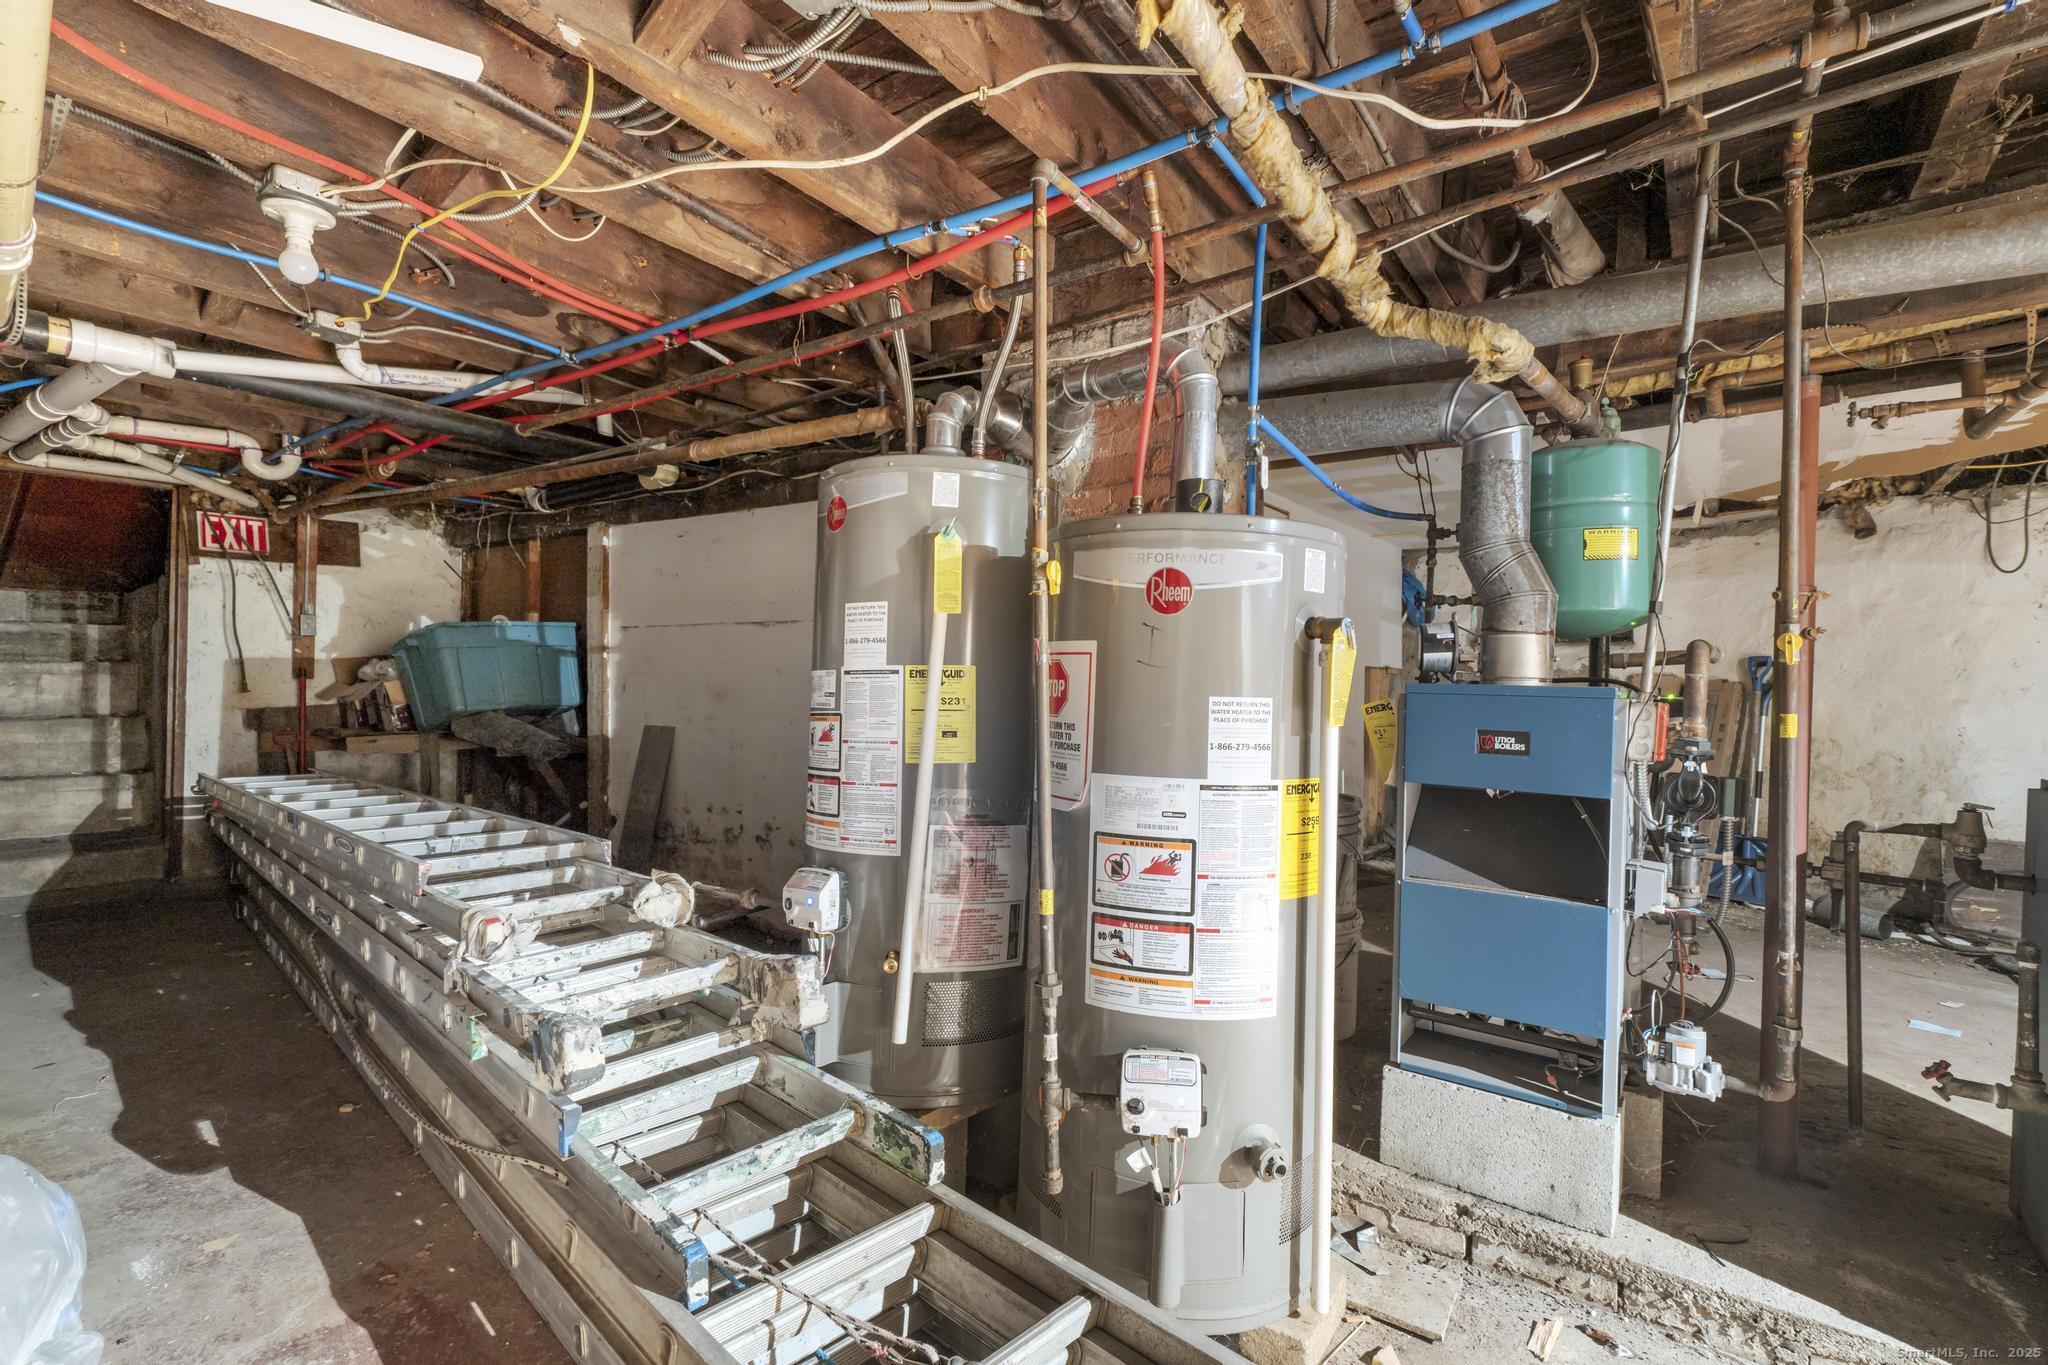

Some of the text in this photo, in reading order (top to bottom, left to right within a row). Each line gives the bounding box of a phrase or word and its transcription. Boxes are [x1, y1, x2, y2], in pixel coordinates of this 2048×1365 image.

[205, 515, 262, 552] EXIT
[1150, 568, 1190, 608] Rheem
[909, 669, 968, 677] ENEGUID
[1049, 679, 1065, 697] TOP
[1050, 722, 1075, 731] ETURN THIS
[1050, 732, 1071, 741] EATER TO
[1054, 742, 1080, 752] PURCHASE
[1209, 742, 1271, 751] 1-866-279-4566
[1495, 743, 1526, 751] BOILERS
[1129, 841, 1164, 849] WARNING
[1129, 922, 1159, 931] DANGER
[1128, 976, 1159, 985] WARNING
